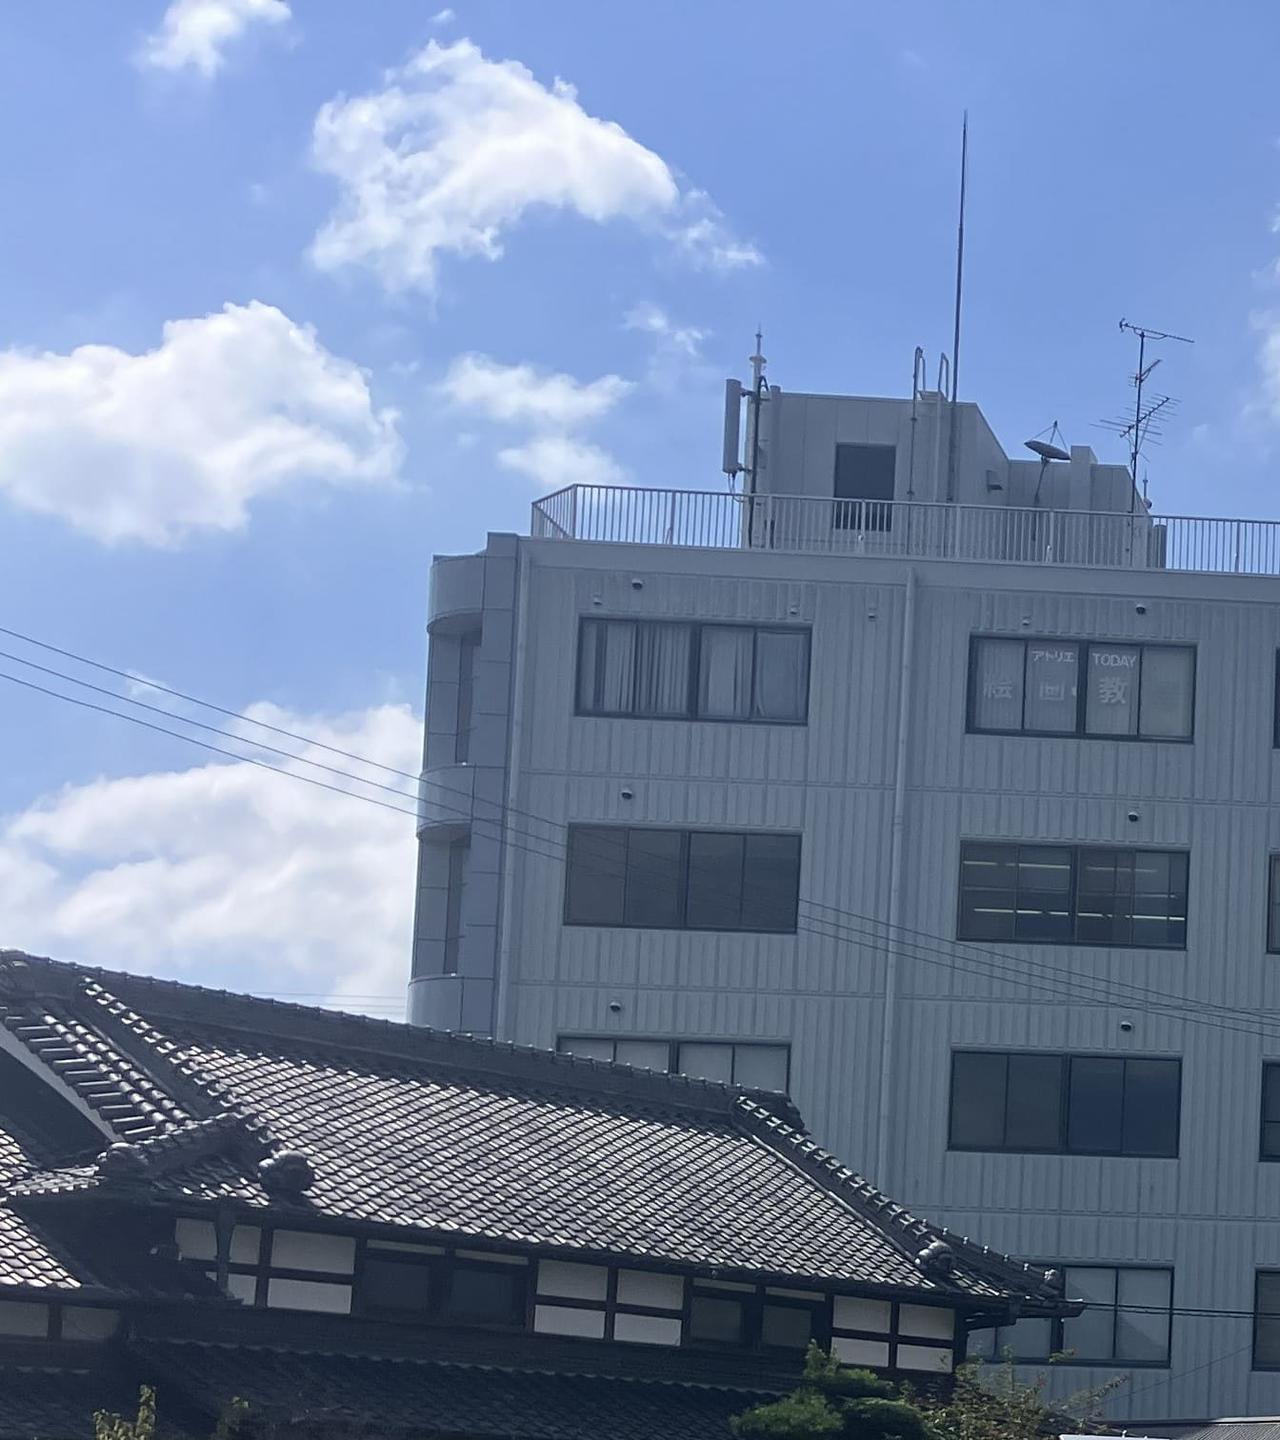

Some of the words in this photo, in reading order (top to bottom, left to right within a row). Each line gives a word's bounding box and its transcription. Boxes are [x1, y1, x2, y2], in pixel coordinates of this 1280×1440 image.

[1031, 650, 1075, 663] アトリエ
[1092, 652, 1137, 668] TODAY
